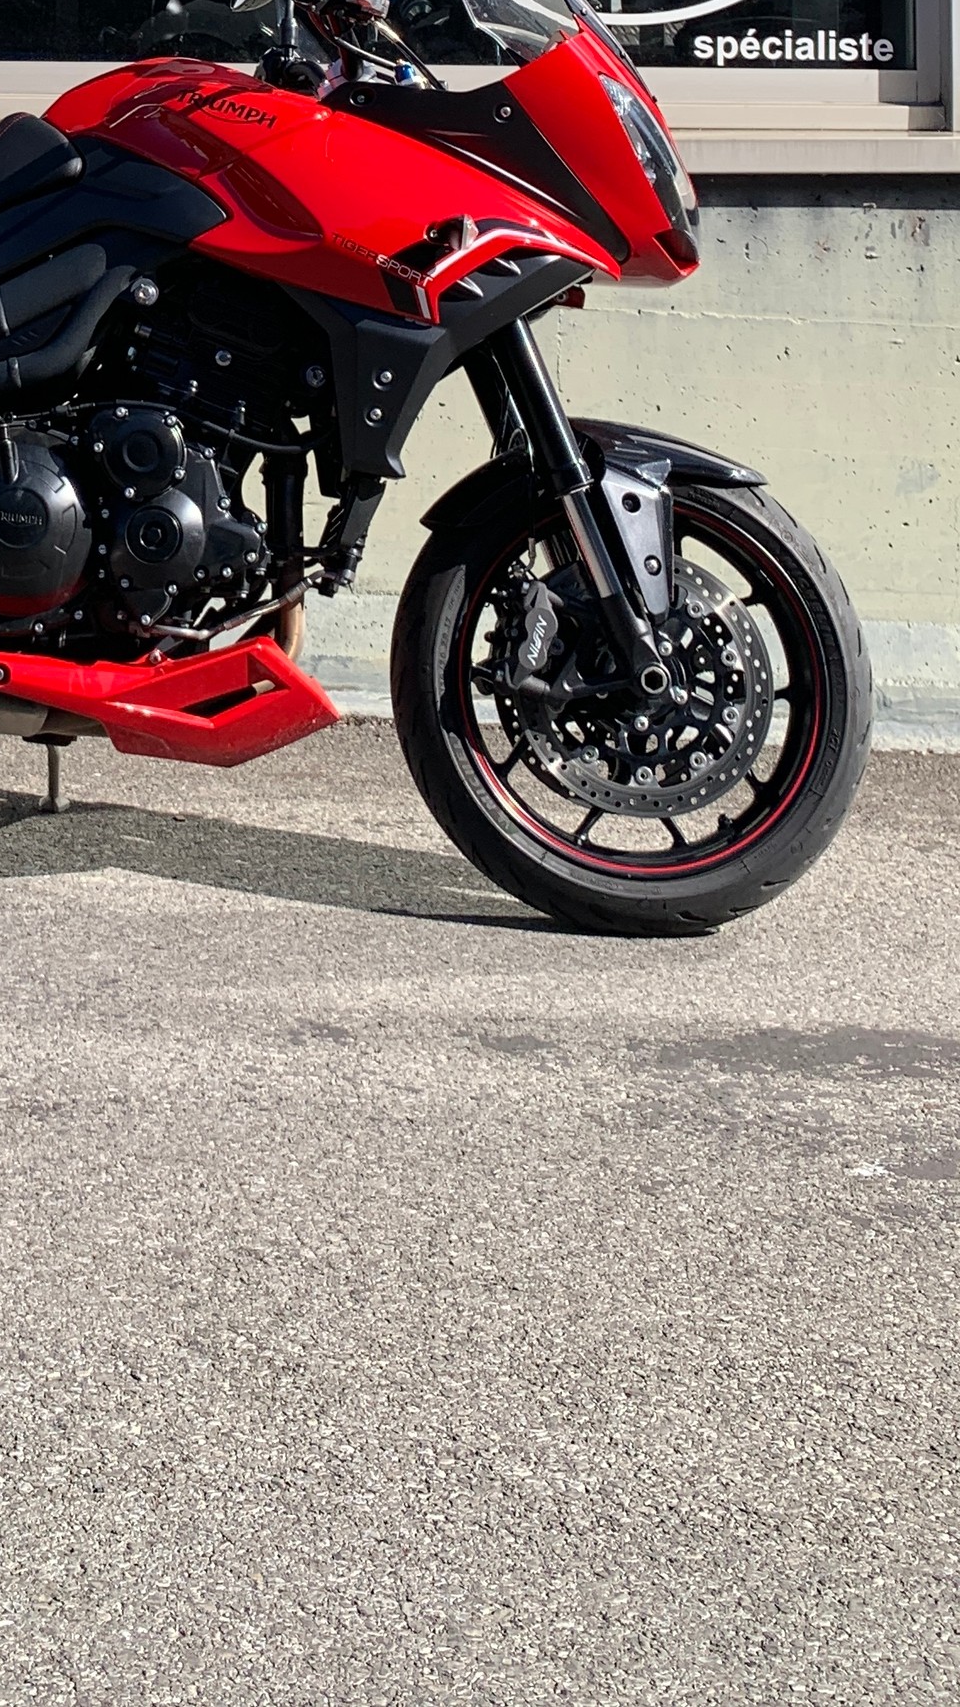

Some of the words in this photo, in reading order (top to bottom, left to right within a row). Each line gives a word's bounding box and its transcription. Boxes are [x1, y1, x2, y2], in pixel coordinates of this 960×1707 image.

[694, 28, 894, 65] spécialiste
[177, 89, 278, 129] TRIUMPH
[526, 614, 547, 666] NISSIN
[451, 738, 497, 810] MICHEL
